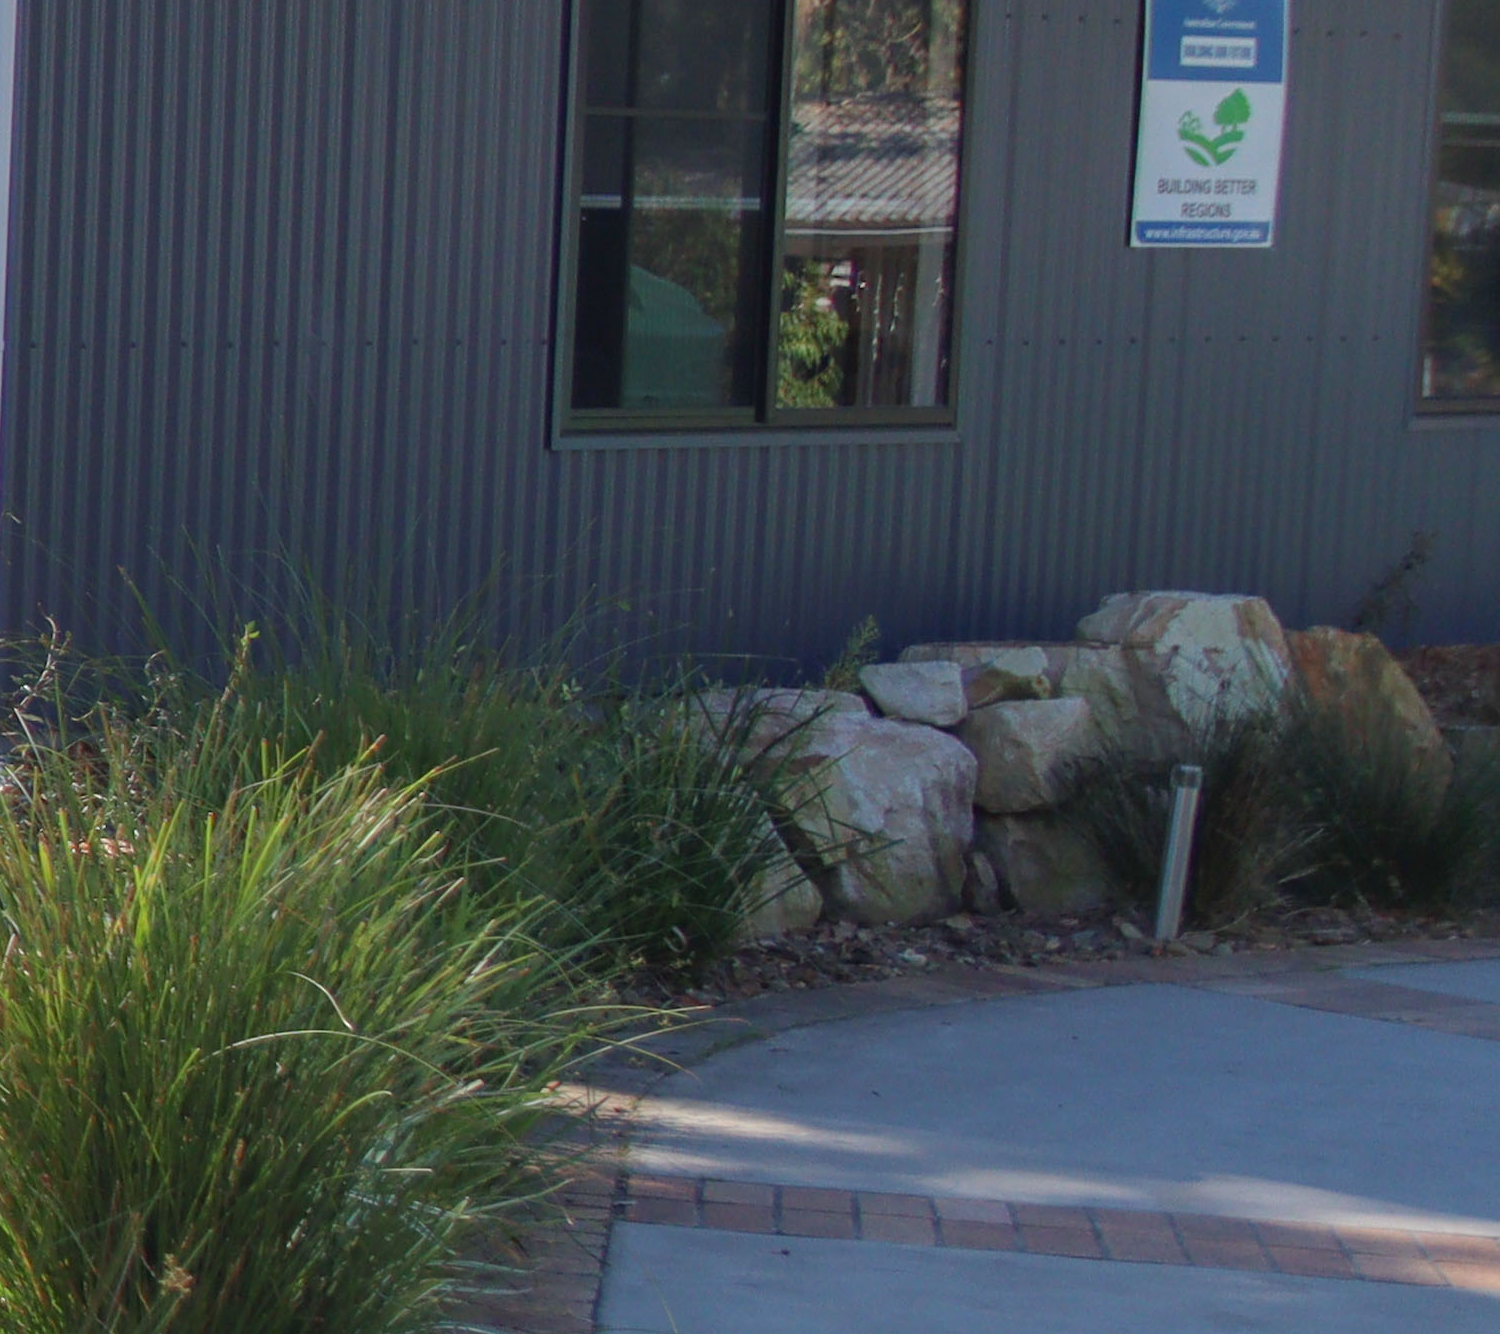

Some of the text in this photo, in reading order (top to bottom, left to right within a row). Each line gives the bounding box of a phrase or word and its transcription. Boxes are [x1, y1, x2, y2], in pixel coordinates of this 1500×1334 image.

[1157, 178, 1256, 195] BUILDING BETTER
[1181, 202, 1232, 218] REGIONS
